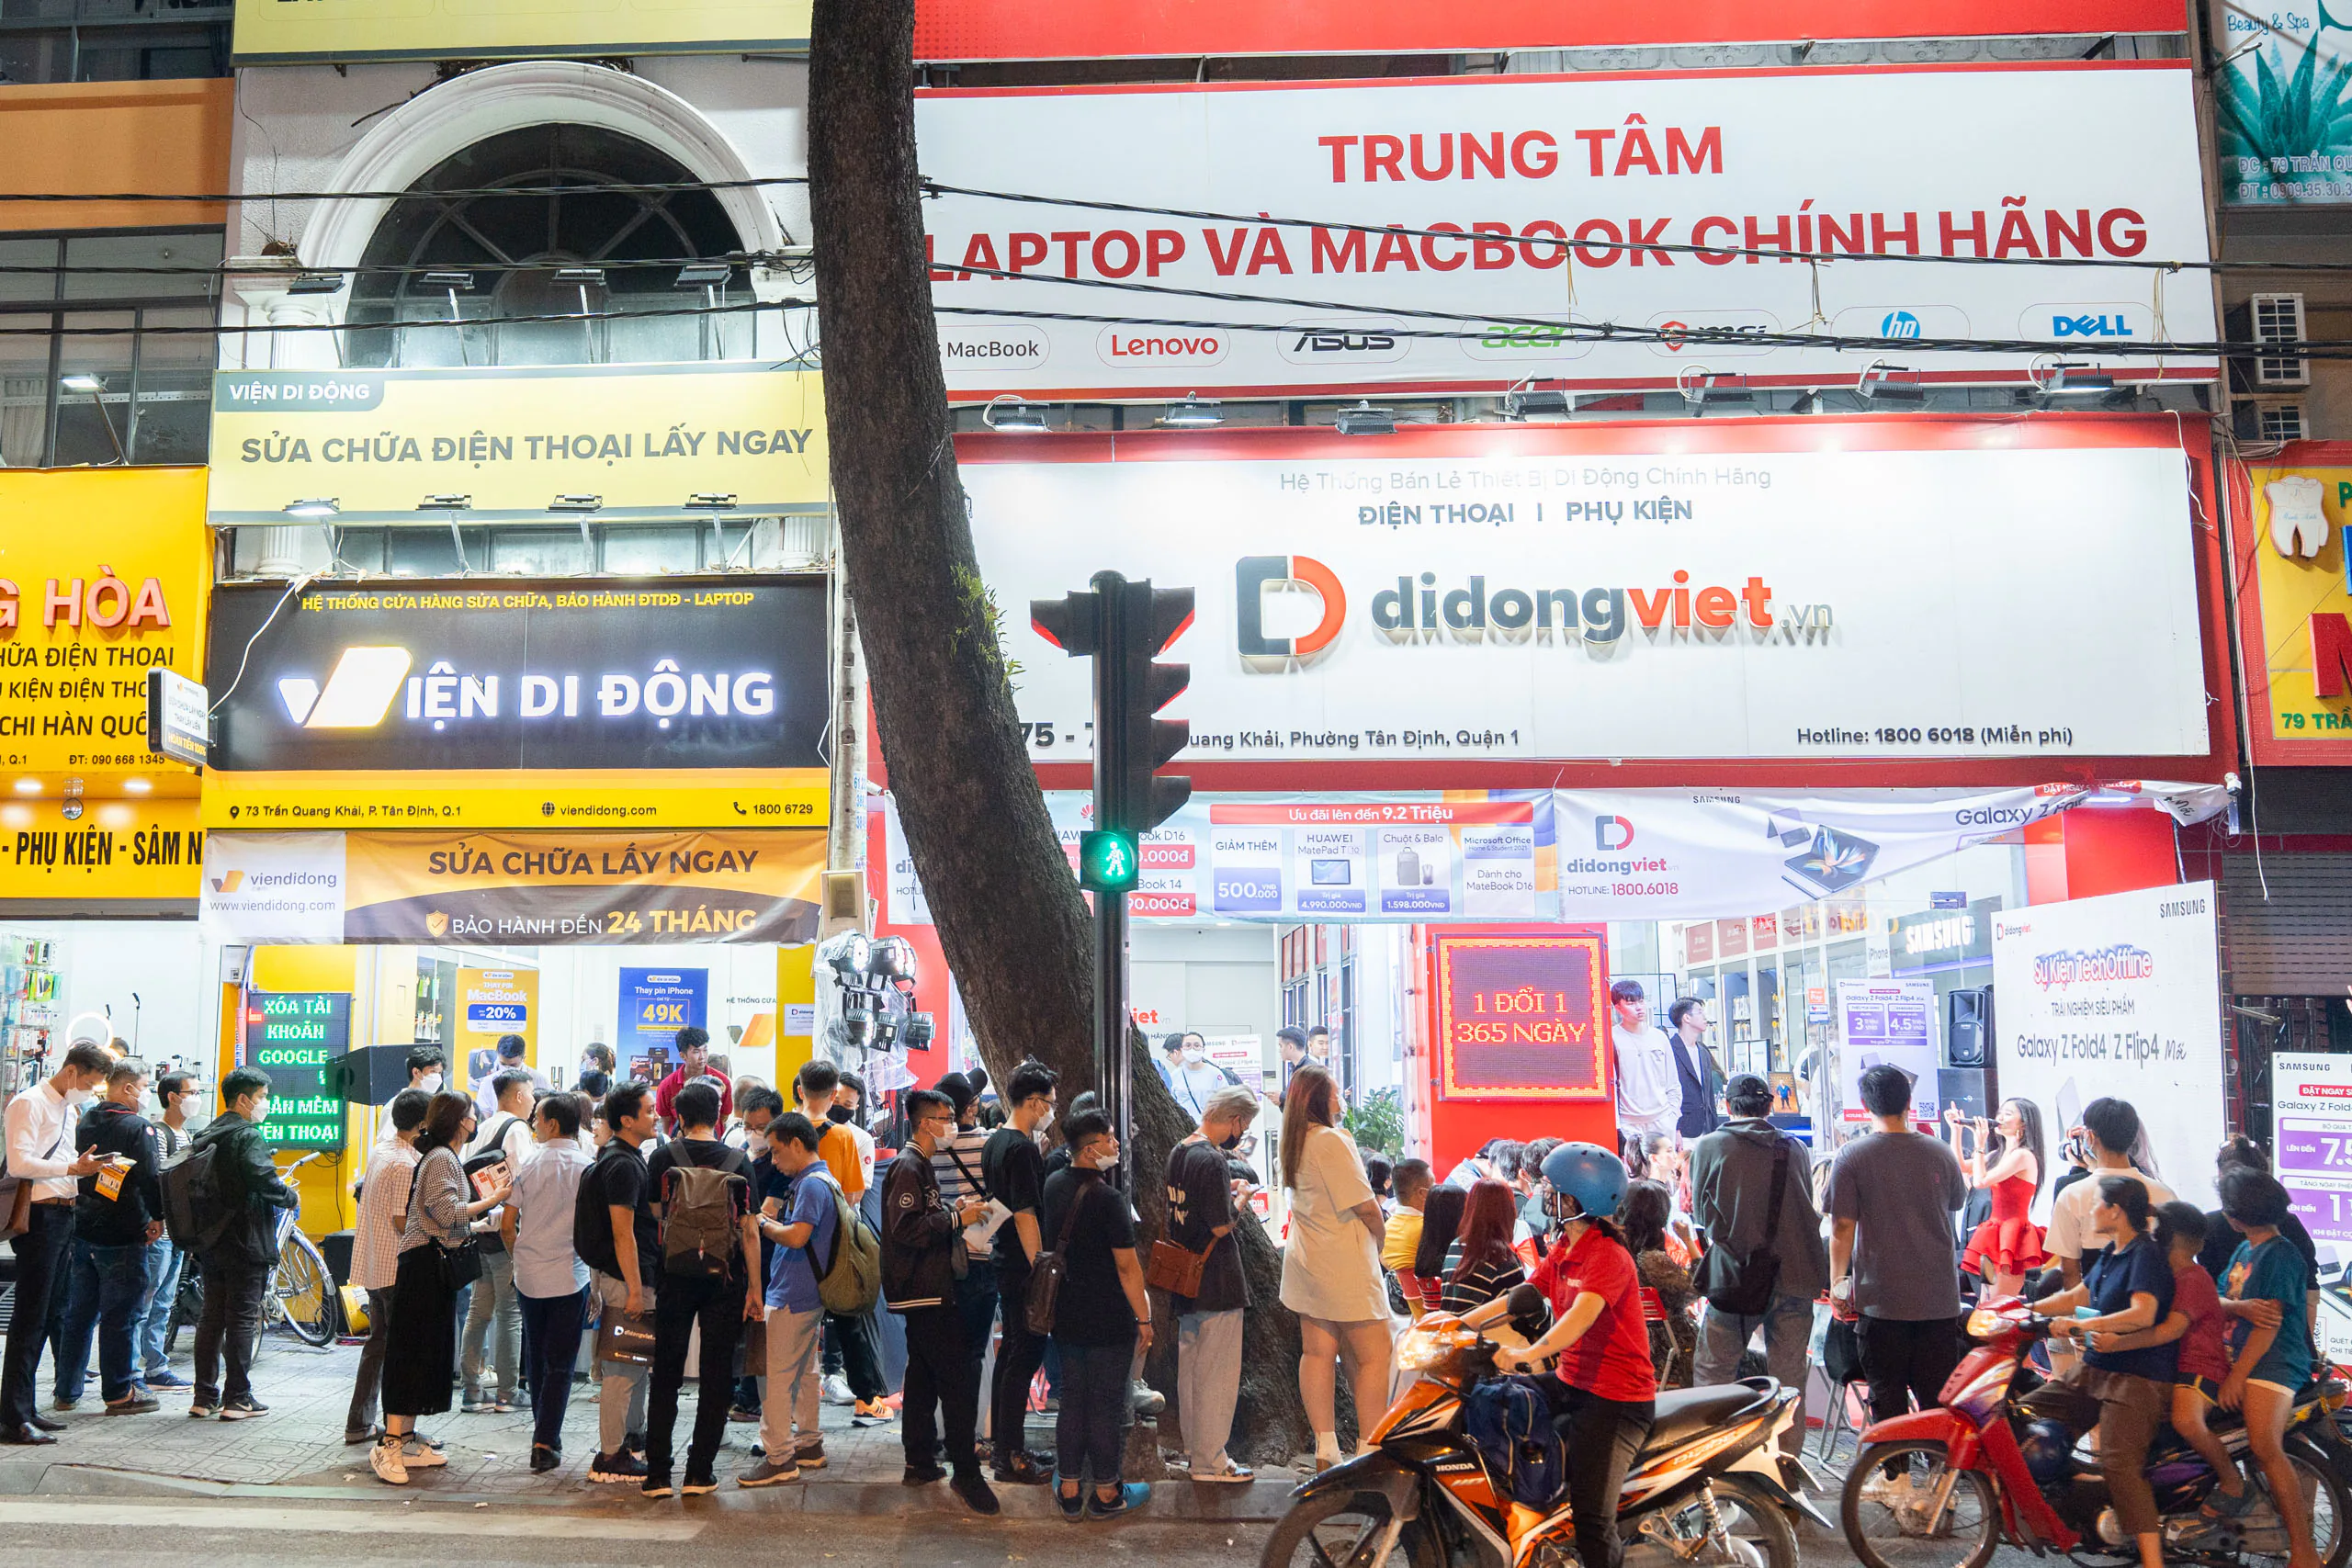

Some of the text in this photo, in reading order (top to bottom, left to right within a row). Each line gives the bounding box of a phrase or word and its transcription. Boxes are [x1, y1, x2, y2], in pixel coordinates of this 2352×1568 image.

[2287, 12, 2310, 33] Spa
[1317, 113, 1723, 183] TRUNG TÂM
[2270, 157, 2288, 173] 79
[927, 196, 2147, 282] LAPTOP VÀ MACBOOK CHÍNH HÃNG
[2052, 314, 2132, 337] DELL
[947, 340, 1039, 357] MacBook
[1112, 333, 1219, 356] Lenovo
[1293, 331, 1395, 353] ASUS
[230, 380, 370, 404] VIỆN DI ĐỘNG
[241, 422, 813, 469] SỬA CHỮA ĐIỆN THOẠI LẤY NGAY
[1281, 474, 1310, 492] Hệ
[1390, 471, 1430, 491] Bán
[1436, 470, 1462, 491] Lẻ
[1582, 468, 1639, 490] Động
[1646, 467, 1707, 487] Chính
[1714, 468, 1771, 491] Hãng
[1358, 495, 1693, 531] ĐIỆN THOẠI PHỤ KIỆN
[43, 564, 172, 627] HÒA
[302, 591, 754, 613] HỆ THỐNG CỬA HÀNG SỬA CHỮA, BẢO HÀNH ĐTDĐ LAPTOP
[1371, 569, 1834, 644] didongviet.vn
[45, 642, 97, 671] ĐIỆN
[9, 678, 104, 702] KIỆN ĐIỆN
[520, 659, 774, 728] DI ĐỘNG
[42, 710, 93, 736] HÀN
[2281, 713, 2305, 729] 79
[1189, 729, 1519, 750] uang Khải, Phường Tân Định, Quận 1
[1797, 725, 2073, 747] Hotline: 1800 6018 (Miễn phí)
[9, 754, 27, 764] Q.1
[69, 754, 165, 764] ĐT: 090 668 1345
[1692, 795, 1741, 804] SAMSUNG
[245, 806, 461, 818] 73 Quang P. Tân Định, Q.1
[560, 805, 657, 818] viendidong.com
[753, 804, 813, 815] 1800 6729
[1309, 808, 1329, 820] đãi
[1332, 808, 1352, 820] lên
[1354, 807, 1380, 820] đến
[1382, 806, 1408, 820] 9.2
[1409, 806, 1453, 823] Triệu
[1955, 806, 2033, 826] Galaxy
[1165, 830, 1186, 840] D16
[1306, 833, 1353, 843] HUAWEI
[1383, 833, 1443, 845] Chuột Balo
[1464, 836, 1532, 845] Microsoft Office
[16, 824, 181, 874] PHỤ KIỆN SÂM
[1216, 839, 1278, 851] GIẢM THÊM
[1297, 845, 1339, 854] MatePad
[428, 842, 759, 875] SỬA CHỮA LẤY NGAY
[250, 871, 337, 888] viendidong
[1477, 869, 1522, 879] Dành cho
[1170, 879, 1182, 889] 14
[1466, 881, 1533, 891] MateBook D16
[1568, 883, 1679, 897] HOTLINE: 1800.6018
[209, 900, 336, 914] www.viendidong.com
[2160, 898, 2206, 919] SAMSUNG
[452, 905, 757, 934] BẢO HÀNH ĐẾN 24 THÁNG
[1905, 915, 1975, 954] SAMSUNG
[2034, 946, 2153, 991] Sự Kiện TechOffline
[467, 988, 527, 1002] MacBook
[635, 987, 694, 995] Thay pin iPhone
[263, 995, 300, 1014] XÓA
[1474, 987, 1567, 1013] 1 ĐỔI 1
[486, 1006, 516, 1020] 20%
[642, 1004, 684, 1022] 49K
[1457, 1018, 1587, 1043] 365 NGÀY
[1854, 1017, 1864, 1031] 3
[1890, 1018, 1912, 1031] 4.5
[258, 1050, 329, 1065] GOOGLE
[2017, 1031, 2160, 1069] Galaxy Z Fold4 Z Flip4
[2278, 1062, 2331, 1072] SAMSUNG
[2302, 1086, 2345, 1096] ĐẶT NGAY
[2278, 1100, 2325, 1112] Galaxy Z
[288, 1124, 339, 1143] THOẠI
[1435, 1462, 1476, 1472] HONDA
